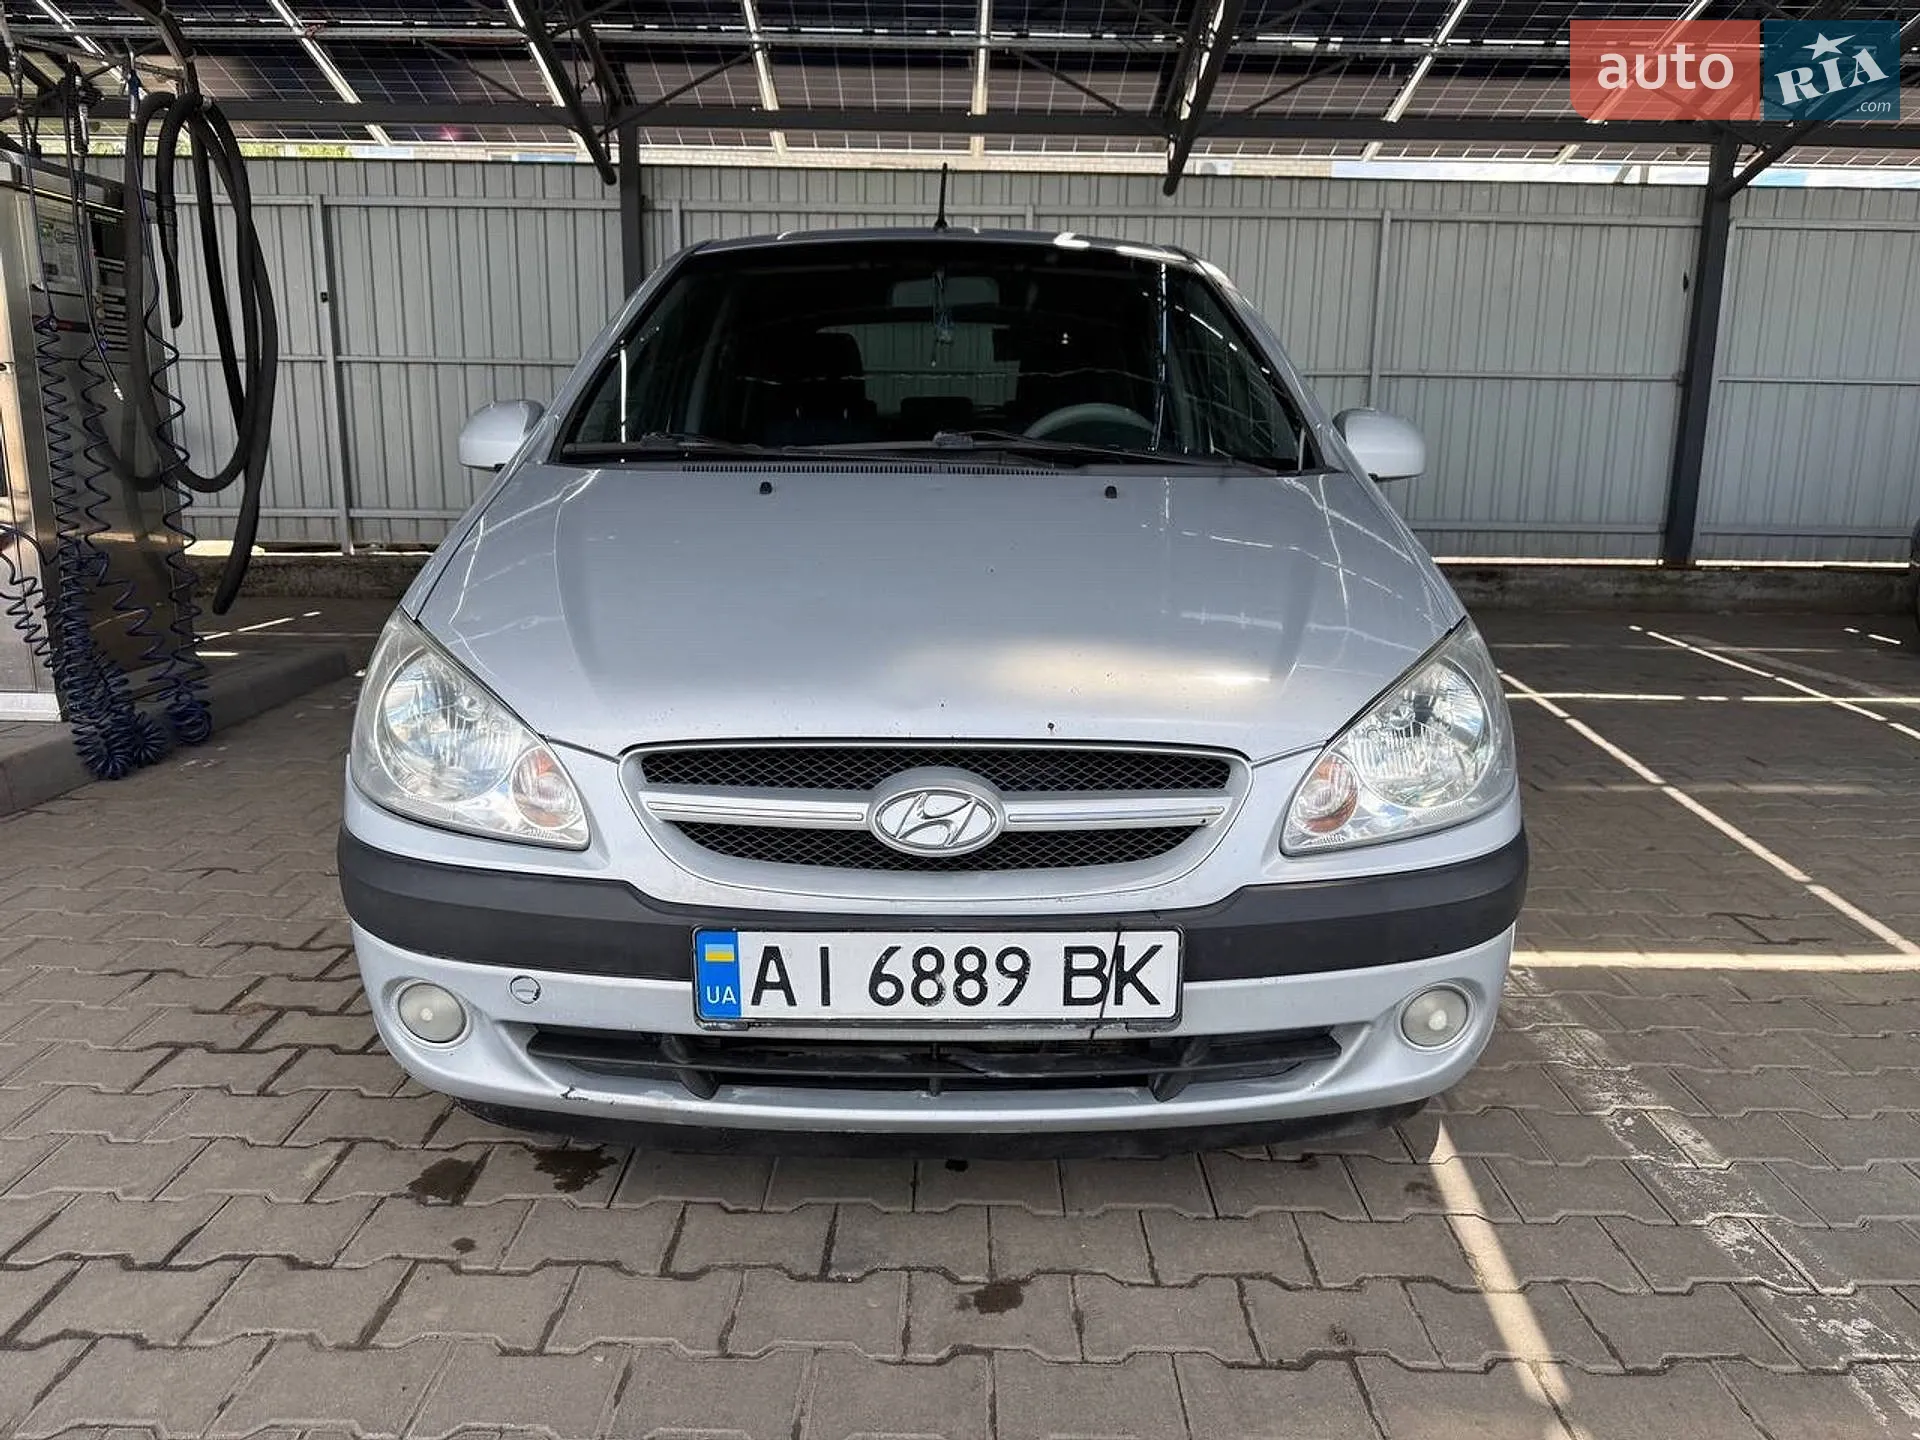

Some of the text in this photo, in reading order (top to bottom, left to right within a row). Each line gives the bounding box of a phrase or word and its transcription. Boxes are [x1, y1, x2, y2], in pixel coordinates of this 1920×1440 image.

[706, 985, 737, 1005] UA
[750, 944, 1164, 1007] AI 6889 BK
